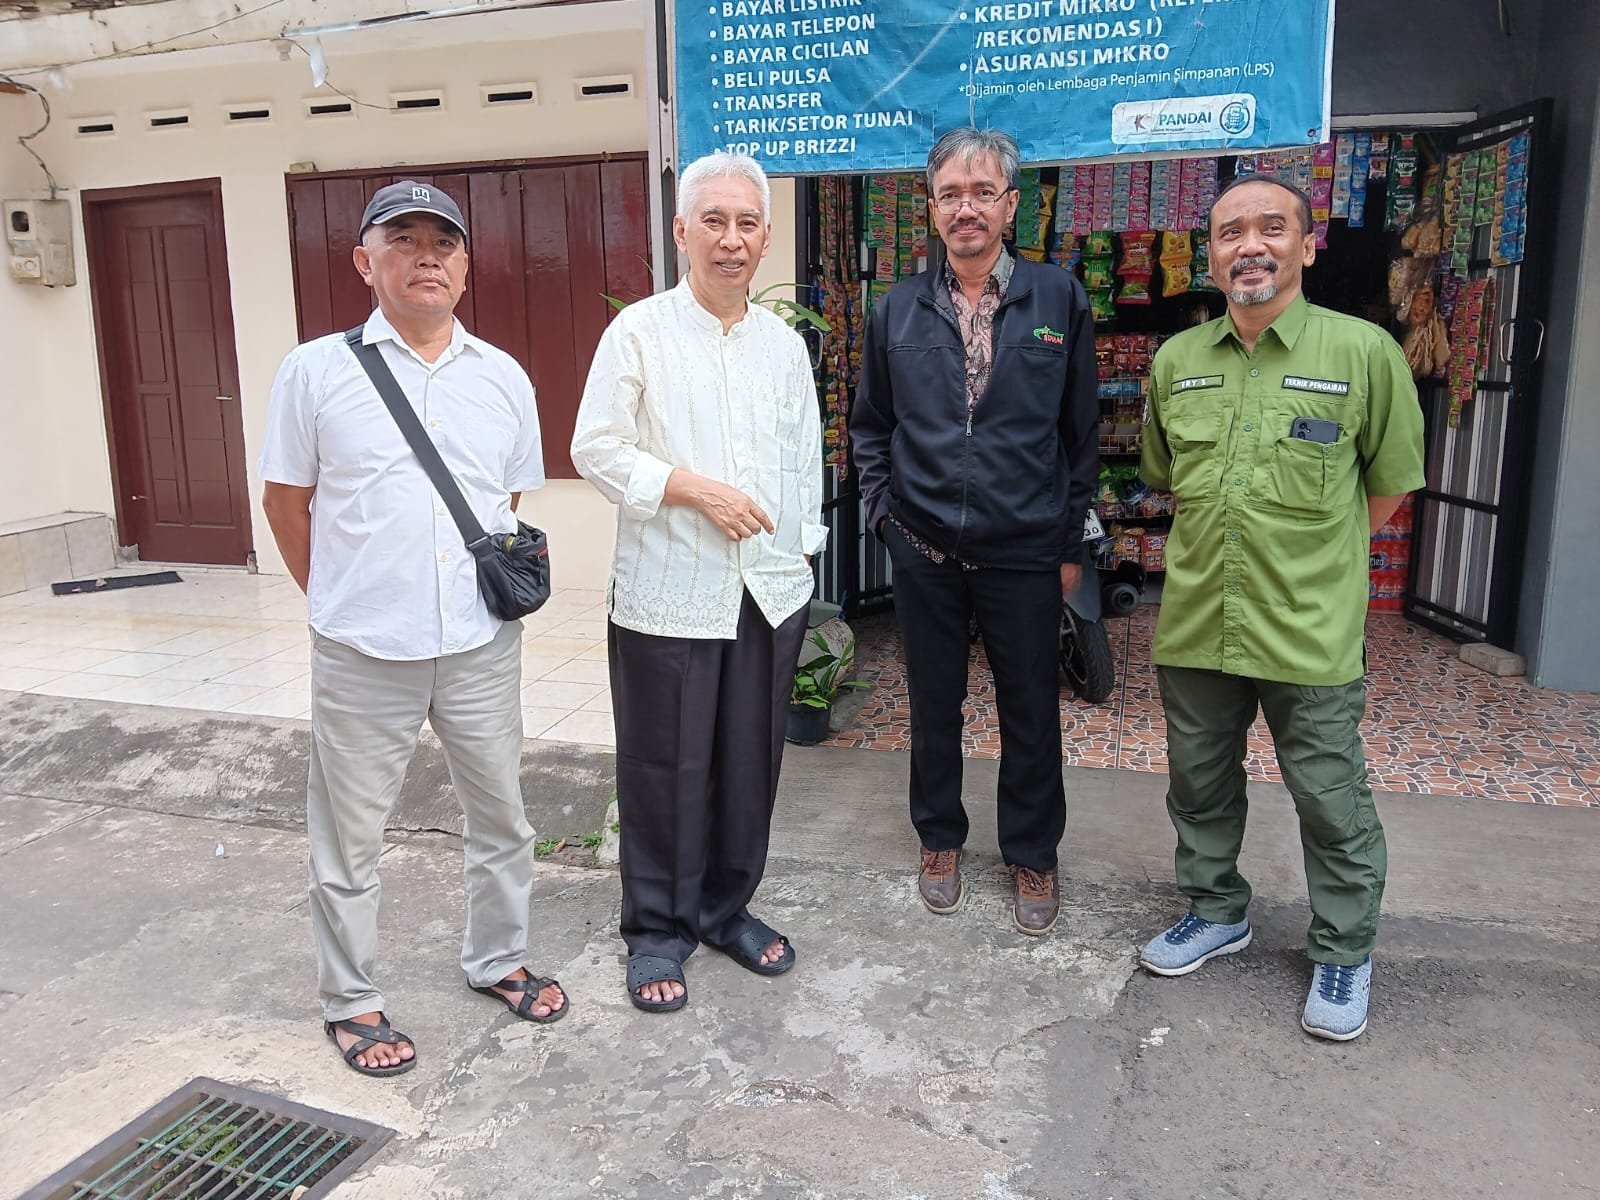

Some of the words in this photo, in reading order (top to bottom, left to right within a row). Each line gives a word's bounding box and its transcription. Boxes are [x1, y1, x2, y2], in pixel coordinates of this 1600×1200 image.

[722, 0, 786, 17] BAYAR
[974, 1, 1053, 23] KREDIT
[723, 22, 786, 41] BAYAR
[791, 13, 875, 37] TELEPON
[724, 46, 787, 65] BAYAR
[792, 39, 869, 61] CICILAN
[975, 49, 1086, 74] ASURANSI
[1093, 43, 1169, 65] MIKRO
[724, 71, 763, 89] BELI
[769, 67, 831, 86] PULSA
[1017, 79, 1045, 93] oleh
[1048, 76, 1107, 91] Lembaga
[1110, 70, 1171, 87] Penjamin
[1174, 64, 1240, 82] Simpanan
[1243, 61, 1275, 78] (LPS)
[724, 92, 822, 112] TRANSFER
[725, 114, 848, 135] TARIK/SETOR
[853, 110, 913, 129] TUNAI
[1159, 111, 1212, 127] PANDAI
[726, 142, 761, 157] TOP
[765, 140, 790, 156] UP
[794, 137, 856, 155] BRIZZI
[1285, 377, 1308, 388] TEKNIK
[1309, 381, 1348, 393] PENGAIRAN
